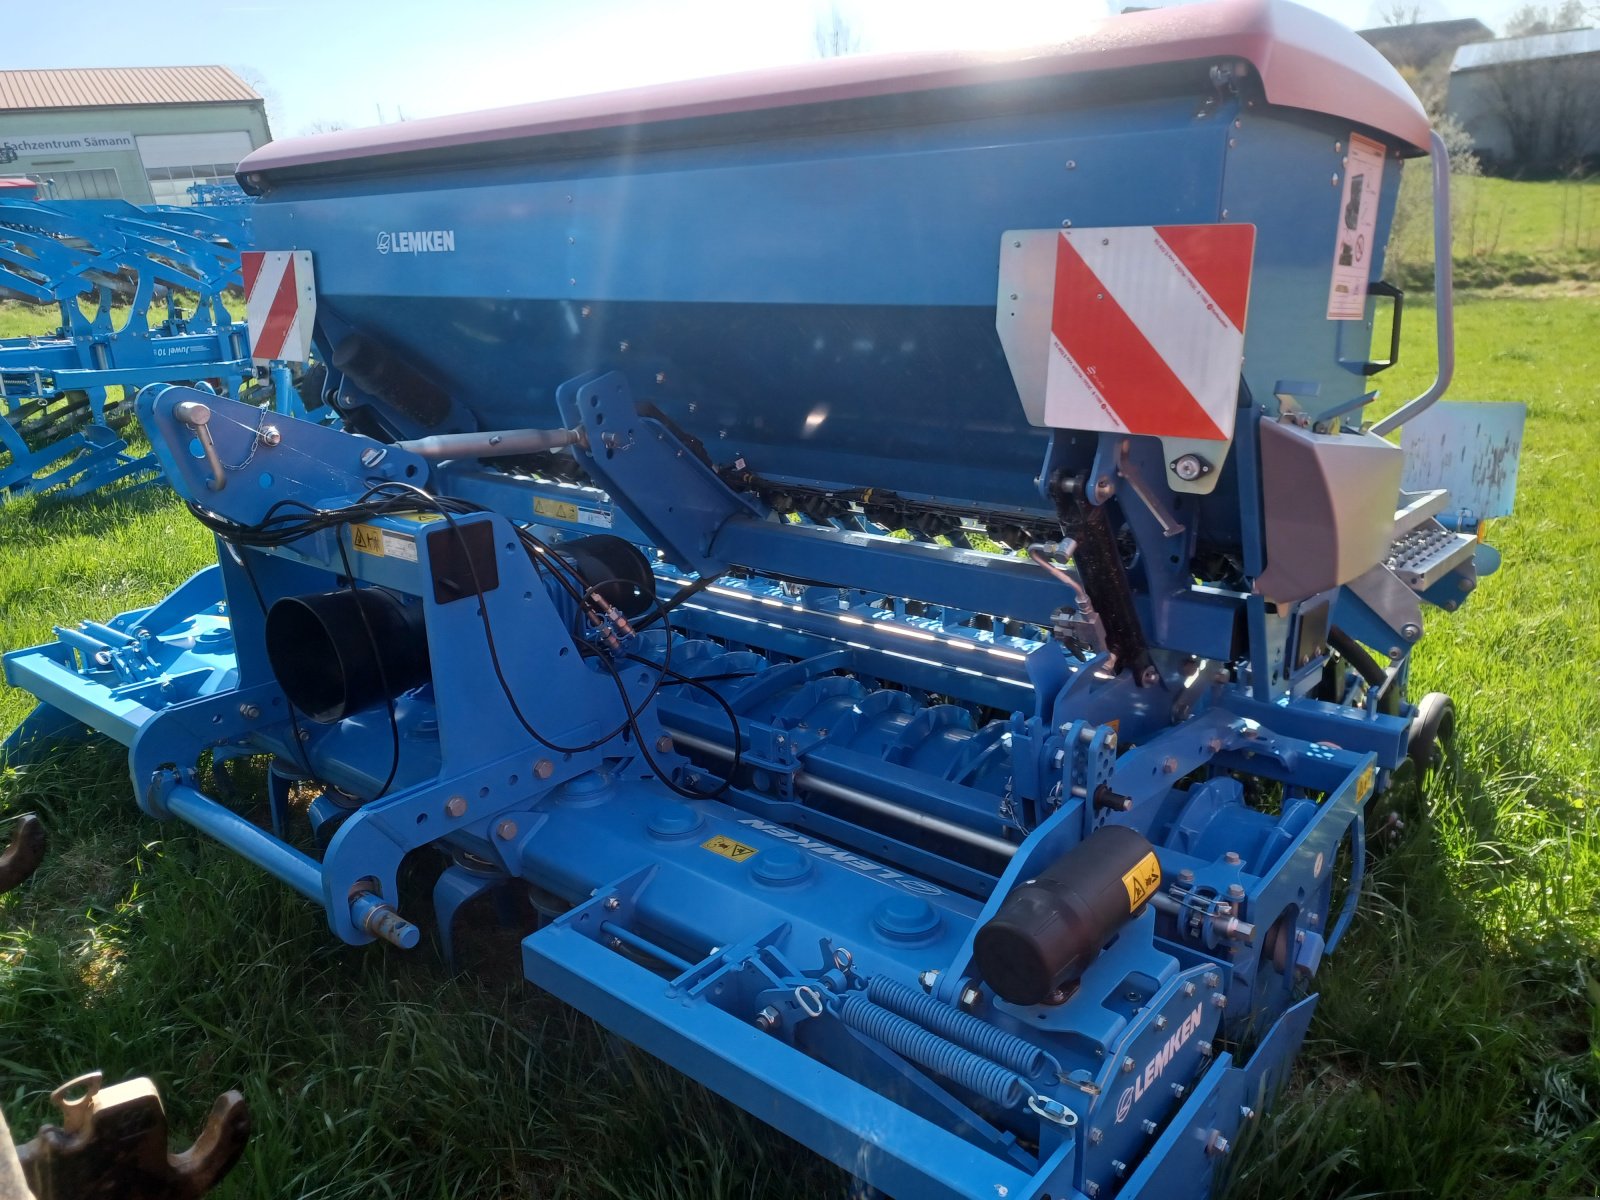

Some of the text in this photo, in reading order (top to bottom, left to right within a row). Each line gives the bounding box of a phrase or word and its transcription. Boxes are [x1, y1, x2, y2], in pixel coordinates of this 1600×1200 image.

[84, 136, 131, 147] Sämann
[391, 230, 455, 256] LEMKEN
[157, 348, 166, 356] 10
[168, 346, 190, 356] Juwel
[737, 819, 904, 879] LEMKEN
[1134, 1001, 1203, 1103] LEMKEN
